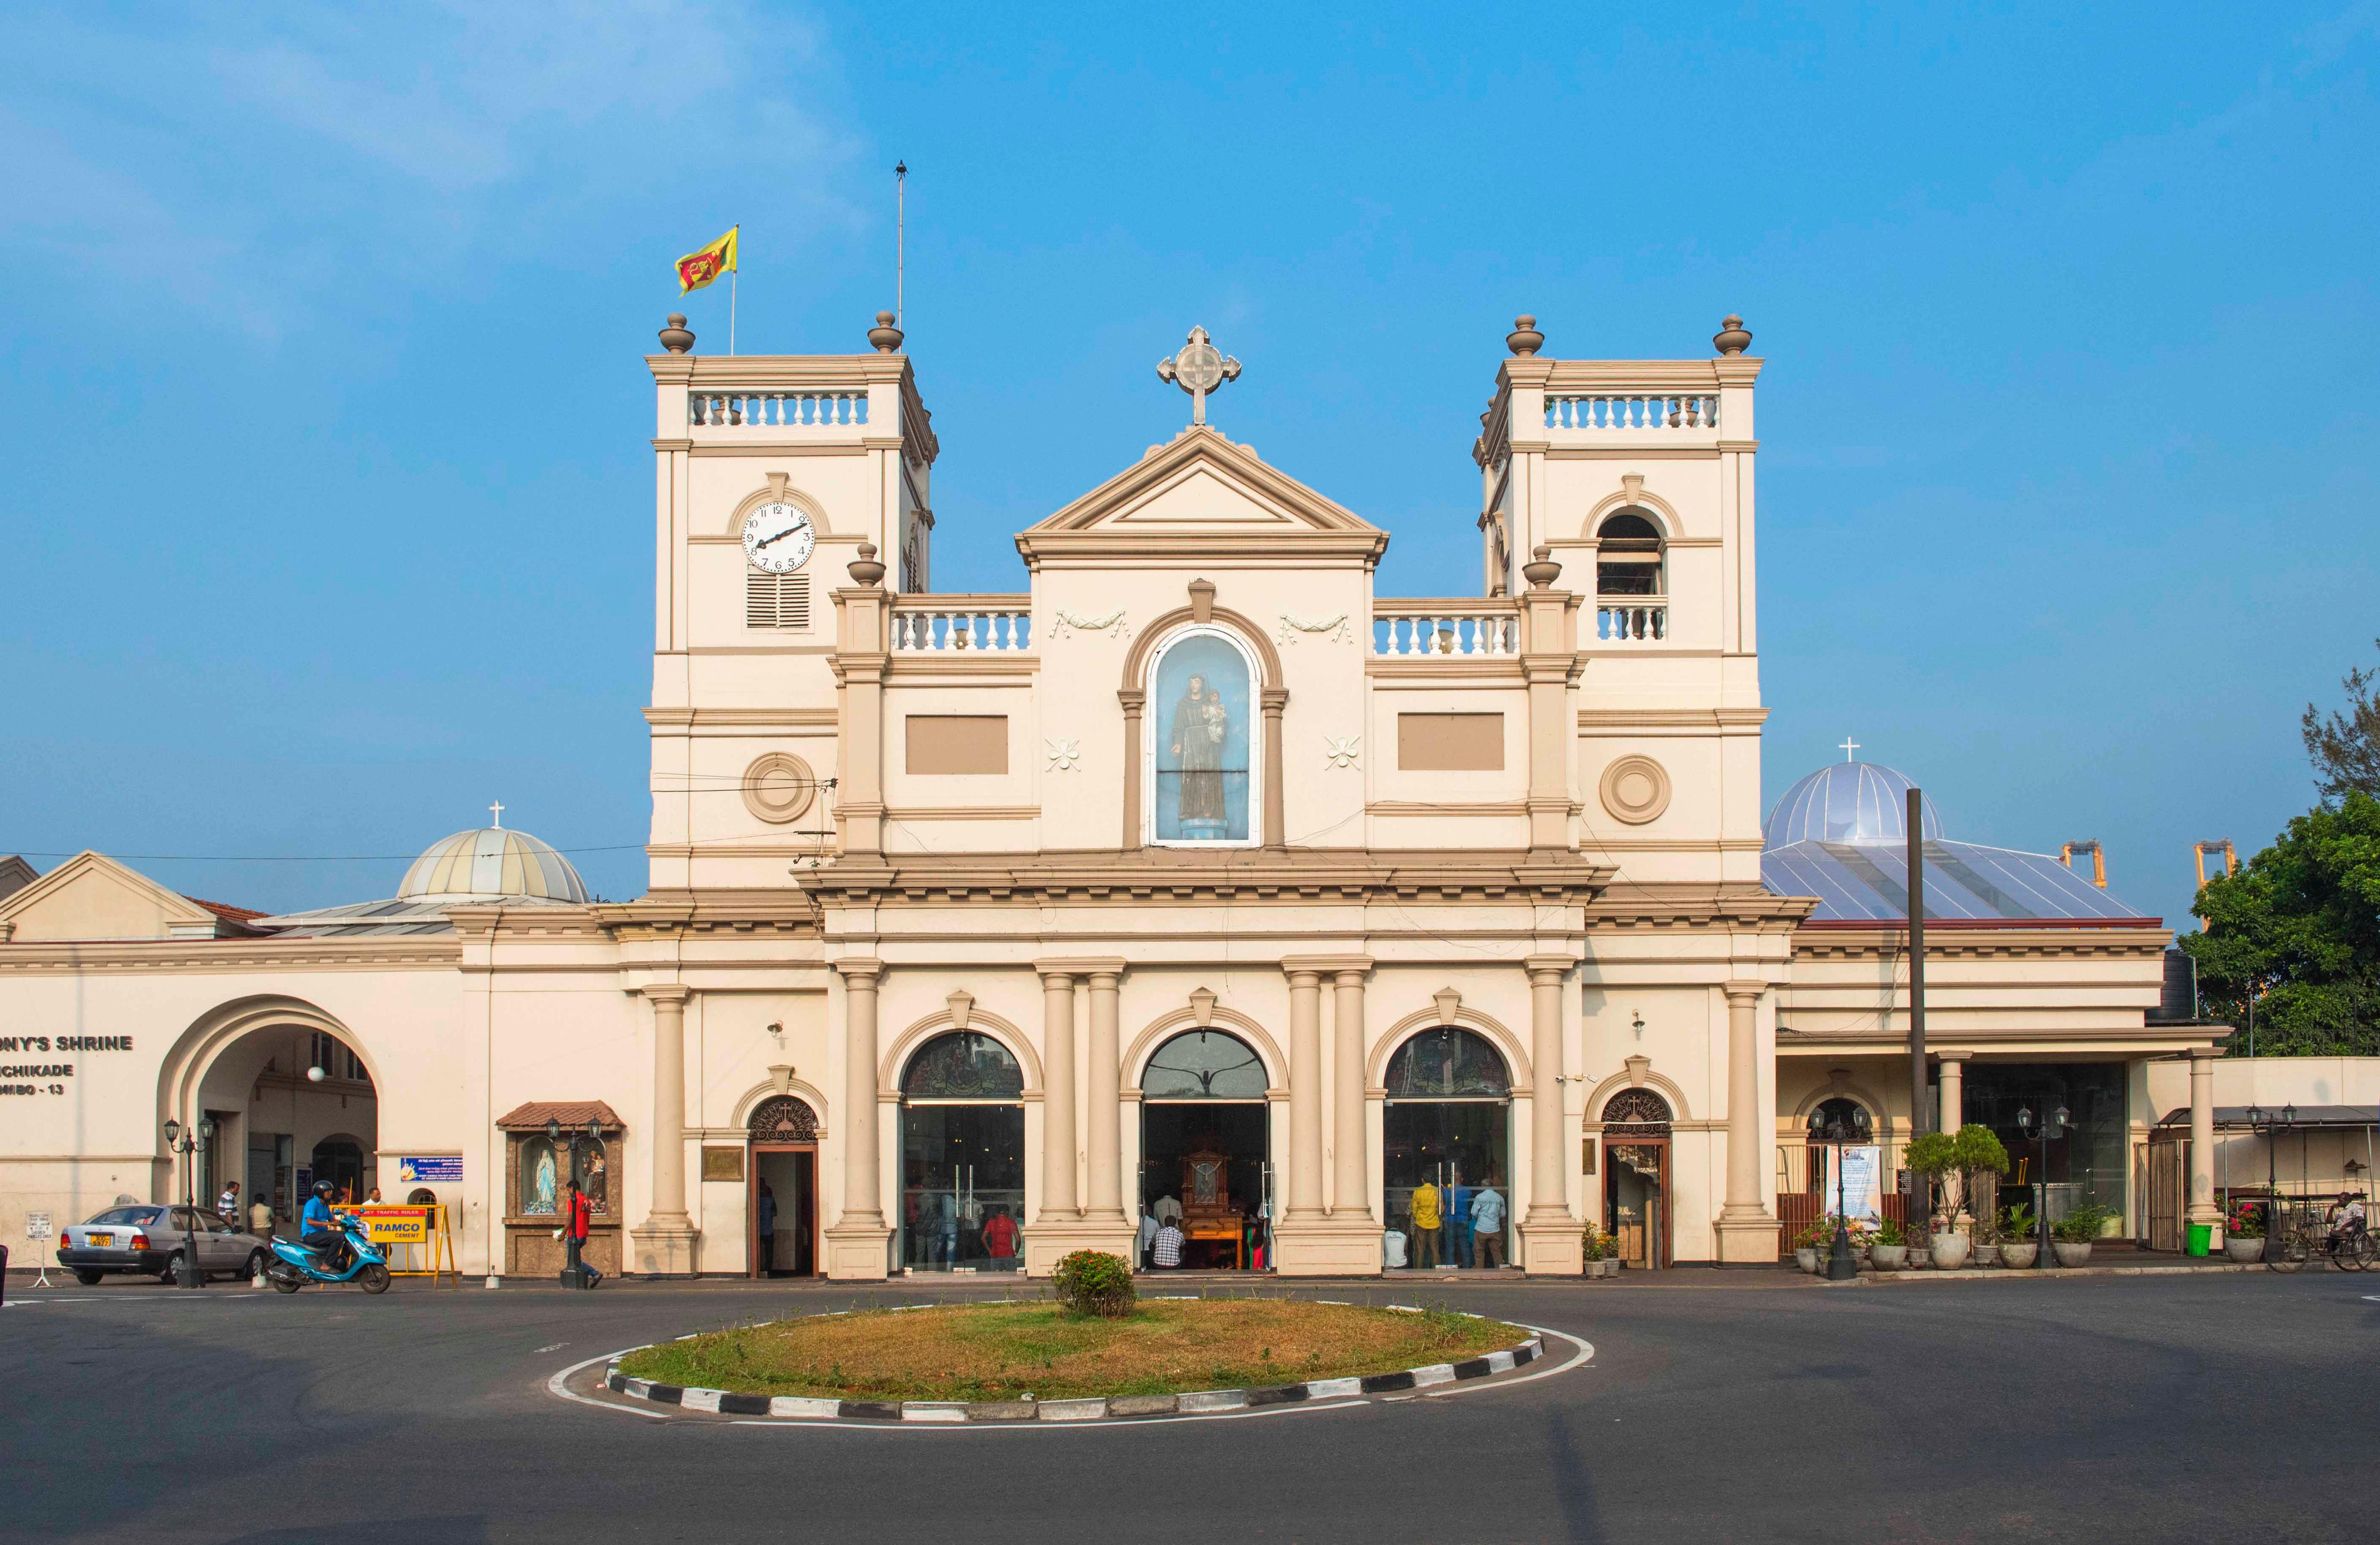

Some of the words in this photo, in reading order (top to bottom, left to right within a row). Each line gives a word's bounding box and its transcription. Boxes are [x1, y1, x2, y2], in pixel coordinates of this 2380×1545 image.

[774, 506, 782, 514] 12
[749, 520, 758, 528] 10
[799, 516, 805, 525] 2
[747, 534, 753, 542] 9
[751, 547, 757, 556] 8
[798, 547, 805, 555] 4
[775, 561, 782, 569] 6
[788, 558, 794, 566] 5
[0, 1037, 50, 1051] NY'S
[57, 1036, 133, 1051] SHRINE
[0, 1065, 74, 1077] CHIKADE
[48, 1084, 64, 1095] 13
[375, 1223, 420, 1232] RAMCO
